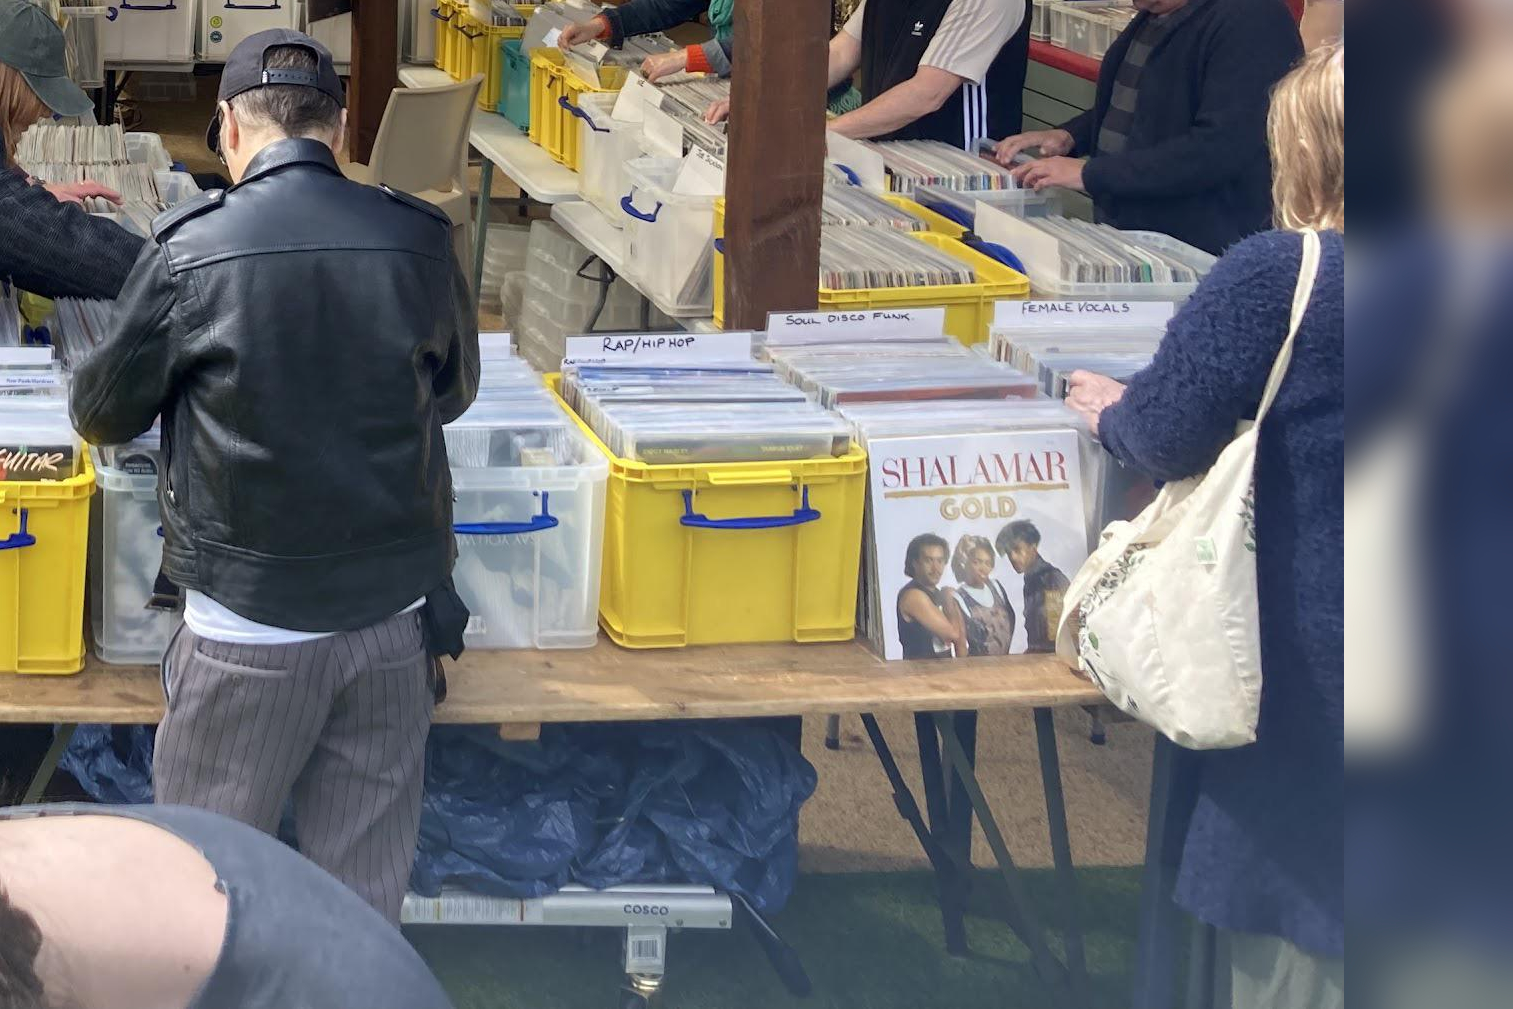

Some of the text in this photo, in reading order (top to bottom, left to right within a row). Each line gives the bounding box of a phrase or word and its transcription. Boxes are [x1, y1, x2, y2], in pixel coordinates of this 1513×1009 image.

[1021, 301, 1131, 314] FEMALE VOCALS
[786, 315, 822, 325] SOUL
[828, 313, 866, 323] DISCO
[882, 450, 1069, 488] SHALAMAR
[939, 496, 1017, 521] GOLD
[623, 903, 670, 917] COSCO
